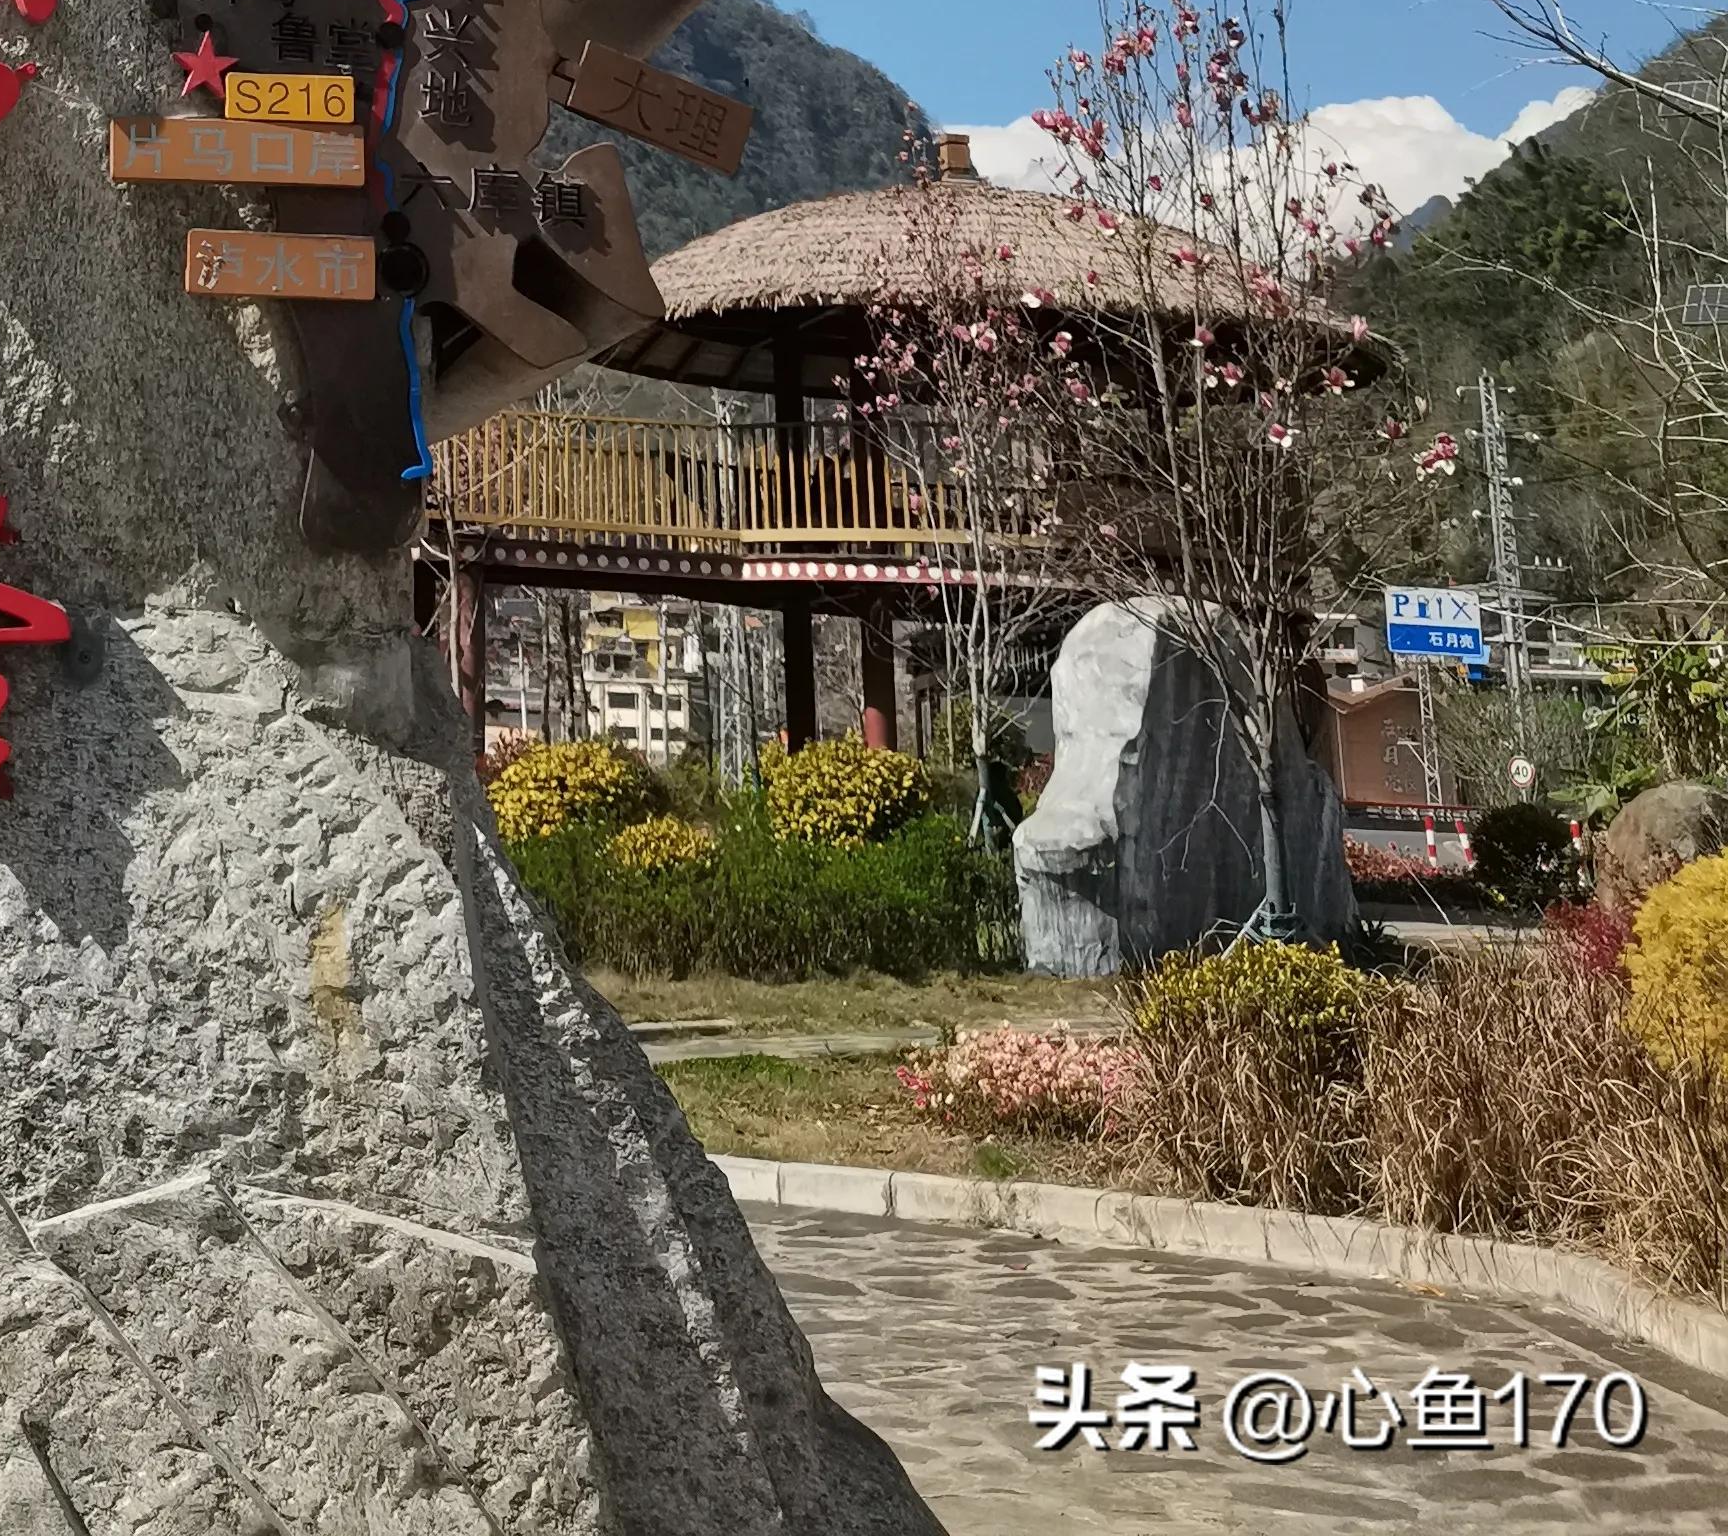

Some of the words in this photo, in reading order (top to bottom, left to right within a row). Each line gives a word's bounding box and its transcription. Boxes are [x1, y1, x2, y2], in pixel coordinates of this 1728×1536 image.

[235, 79, 347, 118] S216
[600, 68, 729, 161] 大理
[124, 124, 361, 180] 片马口岸
[399, 161, 588, 229] 六库镇
[195, 239, 366, 297] 泸水市
[1392, 593, 1410, 618] P
[1428, 631, 1475, 649] 石月亮
